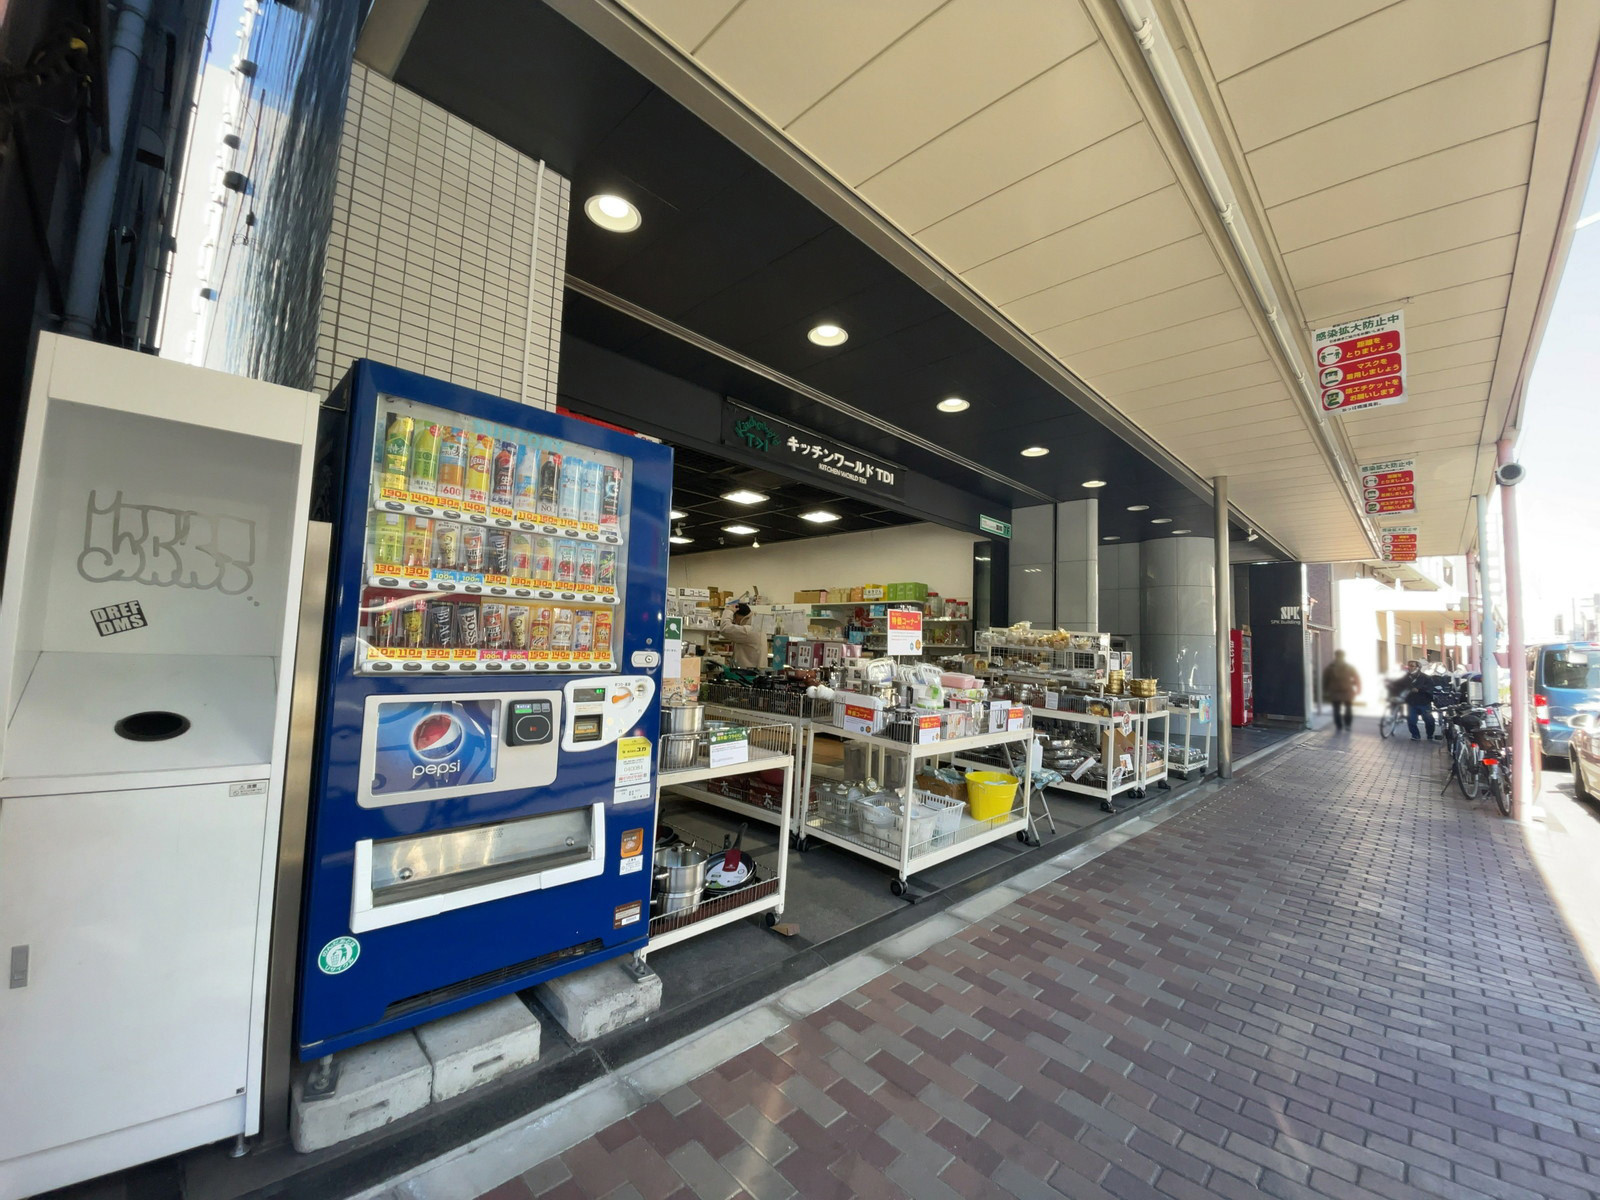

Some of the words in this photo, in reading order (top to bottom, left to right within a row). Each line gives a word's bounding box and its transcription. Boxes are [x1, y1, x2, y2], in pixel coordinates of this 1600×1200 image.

[1315, 314, 1400, 342] 感染拡大防止中
[1346, 342, 1393, 358] とりましょう
[1346, 364, 1400, 380] 着用しましょう
[1356, 358, 1388, 369] マスクを
[1349, 387, 1395, 401] お願いします
[786, 435, 874, 478] キッチンワールド
[875, 467, 895, 486] TDI
[818, 462, 841, 477] KITCHEN
[840, 470, 860, 483] WORLD
[858, 475, 868, 485] TDI
[92, 600, 141, 624] DREF
[1280, 606, 1301, 620] SPK
[99, 613, 146, 636] DMS
[465, 609, 478, 646] BOSS
[412, 759, 461, 779] pepsi
[325, 957, 354, 972] リサイクル
